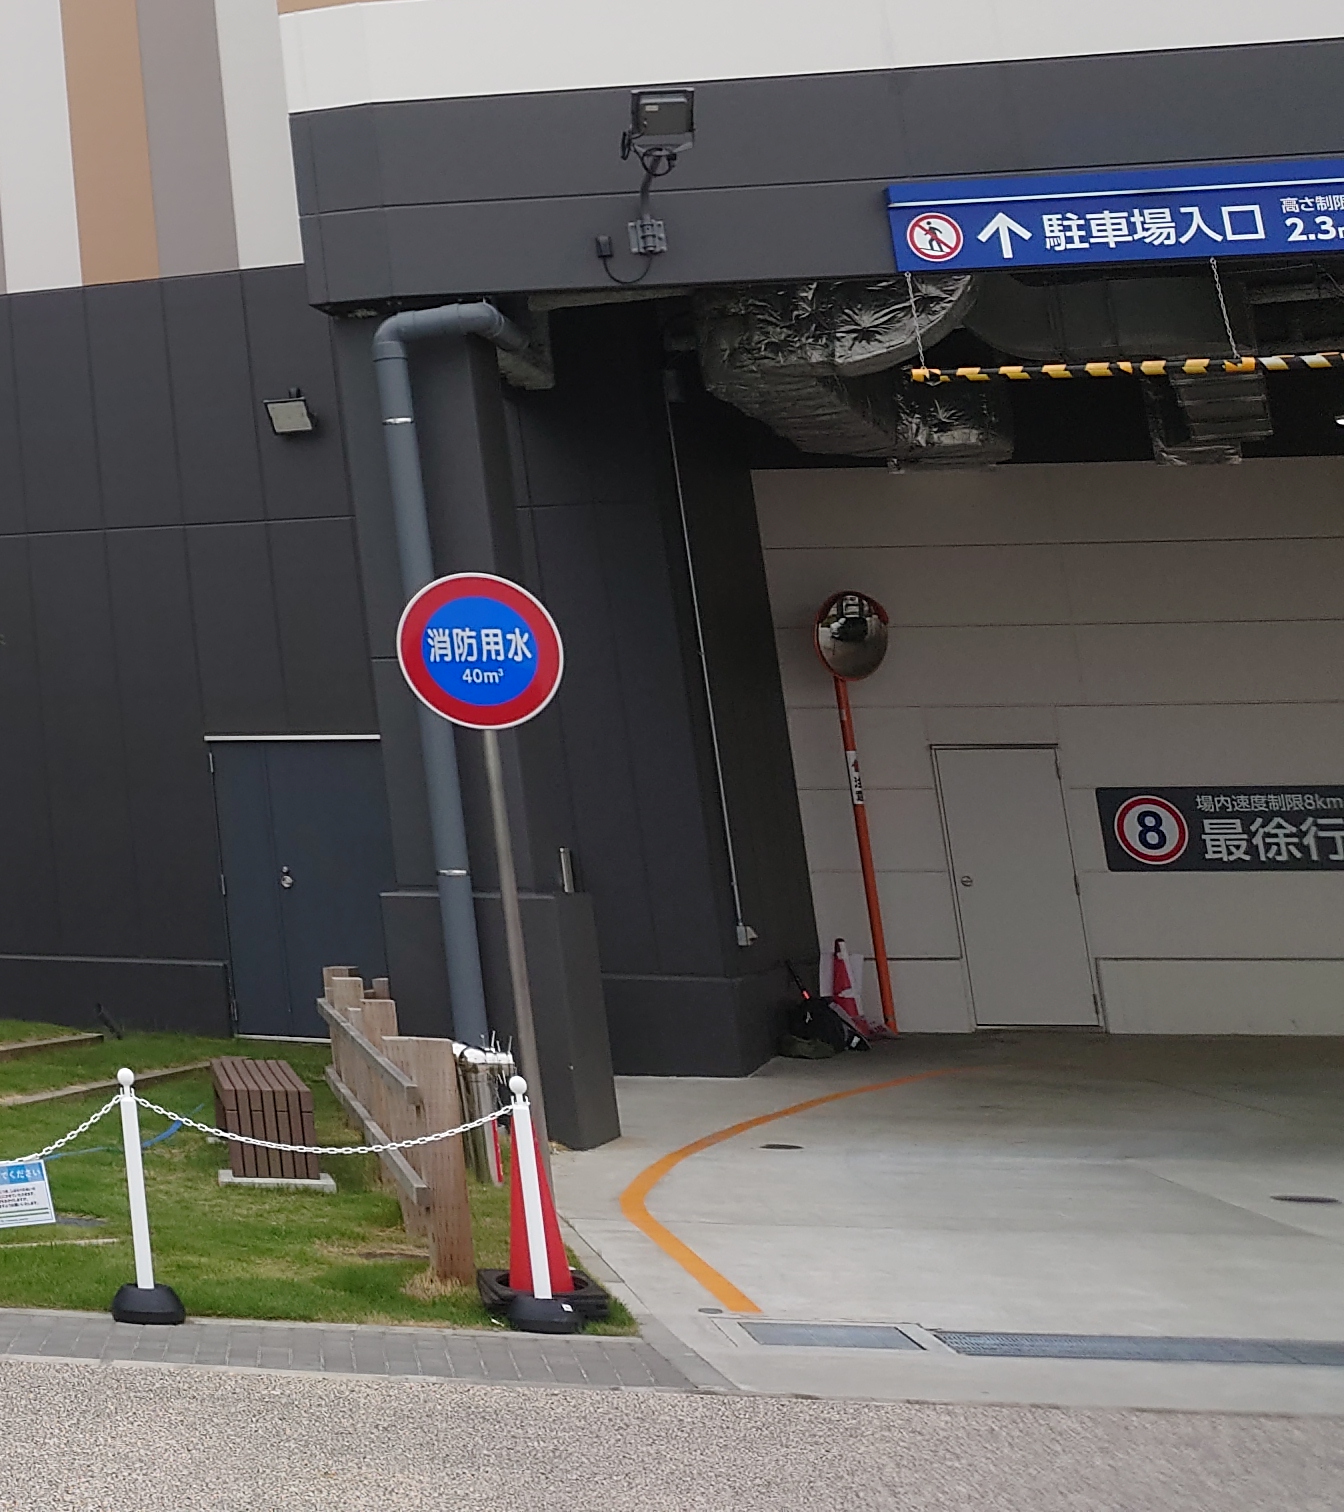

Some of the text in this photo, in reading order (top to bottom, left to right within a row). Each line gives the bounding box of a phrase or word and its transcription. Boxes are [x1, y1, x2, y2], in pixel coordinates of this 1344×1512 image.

[1043, 204, 1266, 251] 駐車場入口
[427, 627, 532, 663] 消防用水
[1136, 810, 1168, 850] 8
[1201, 816, 1344, 862] 最徐行
